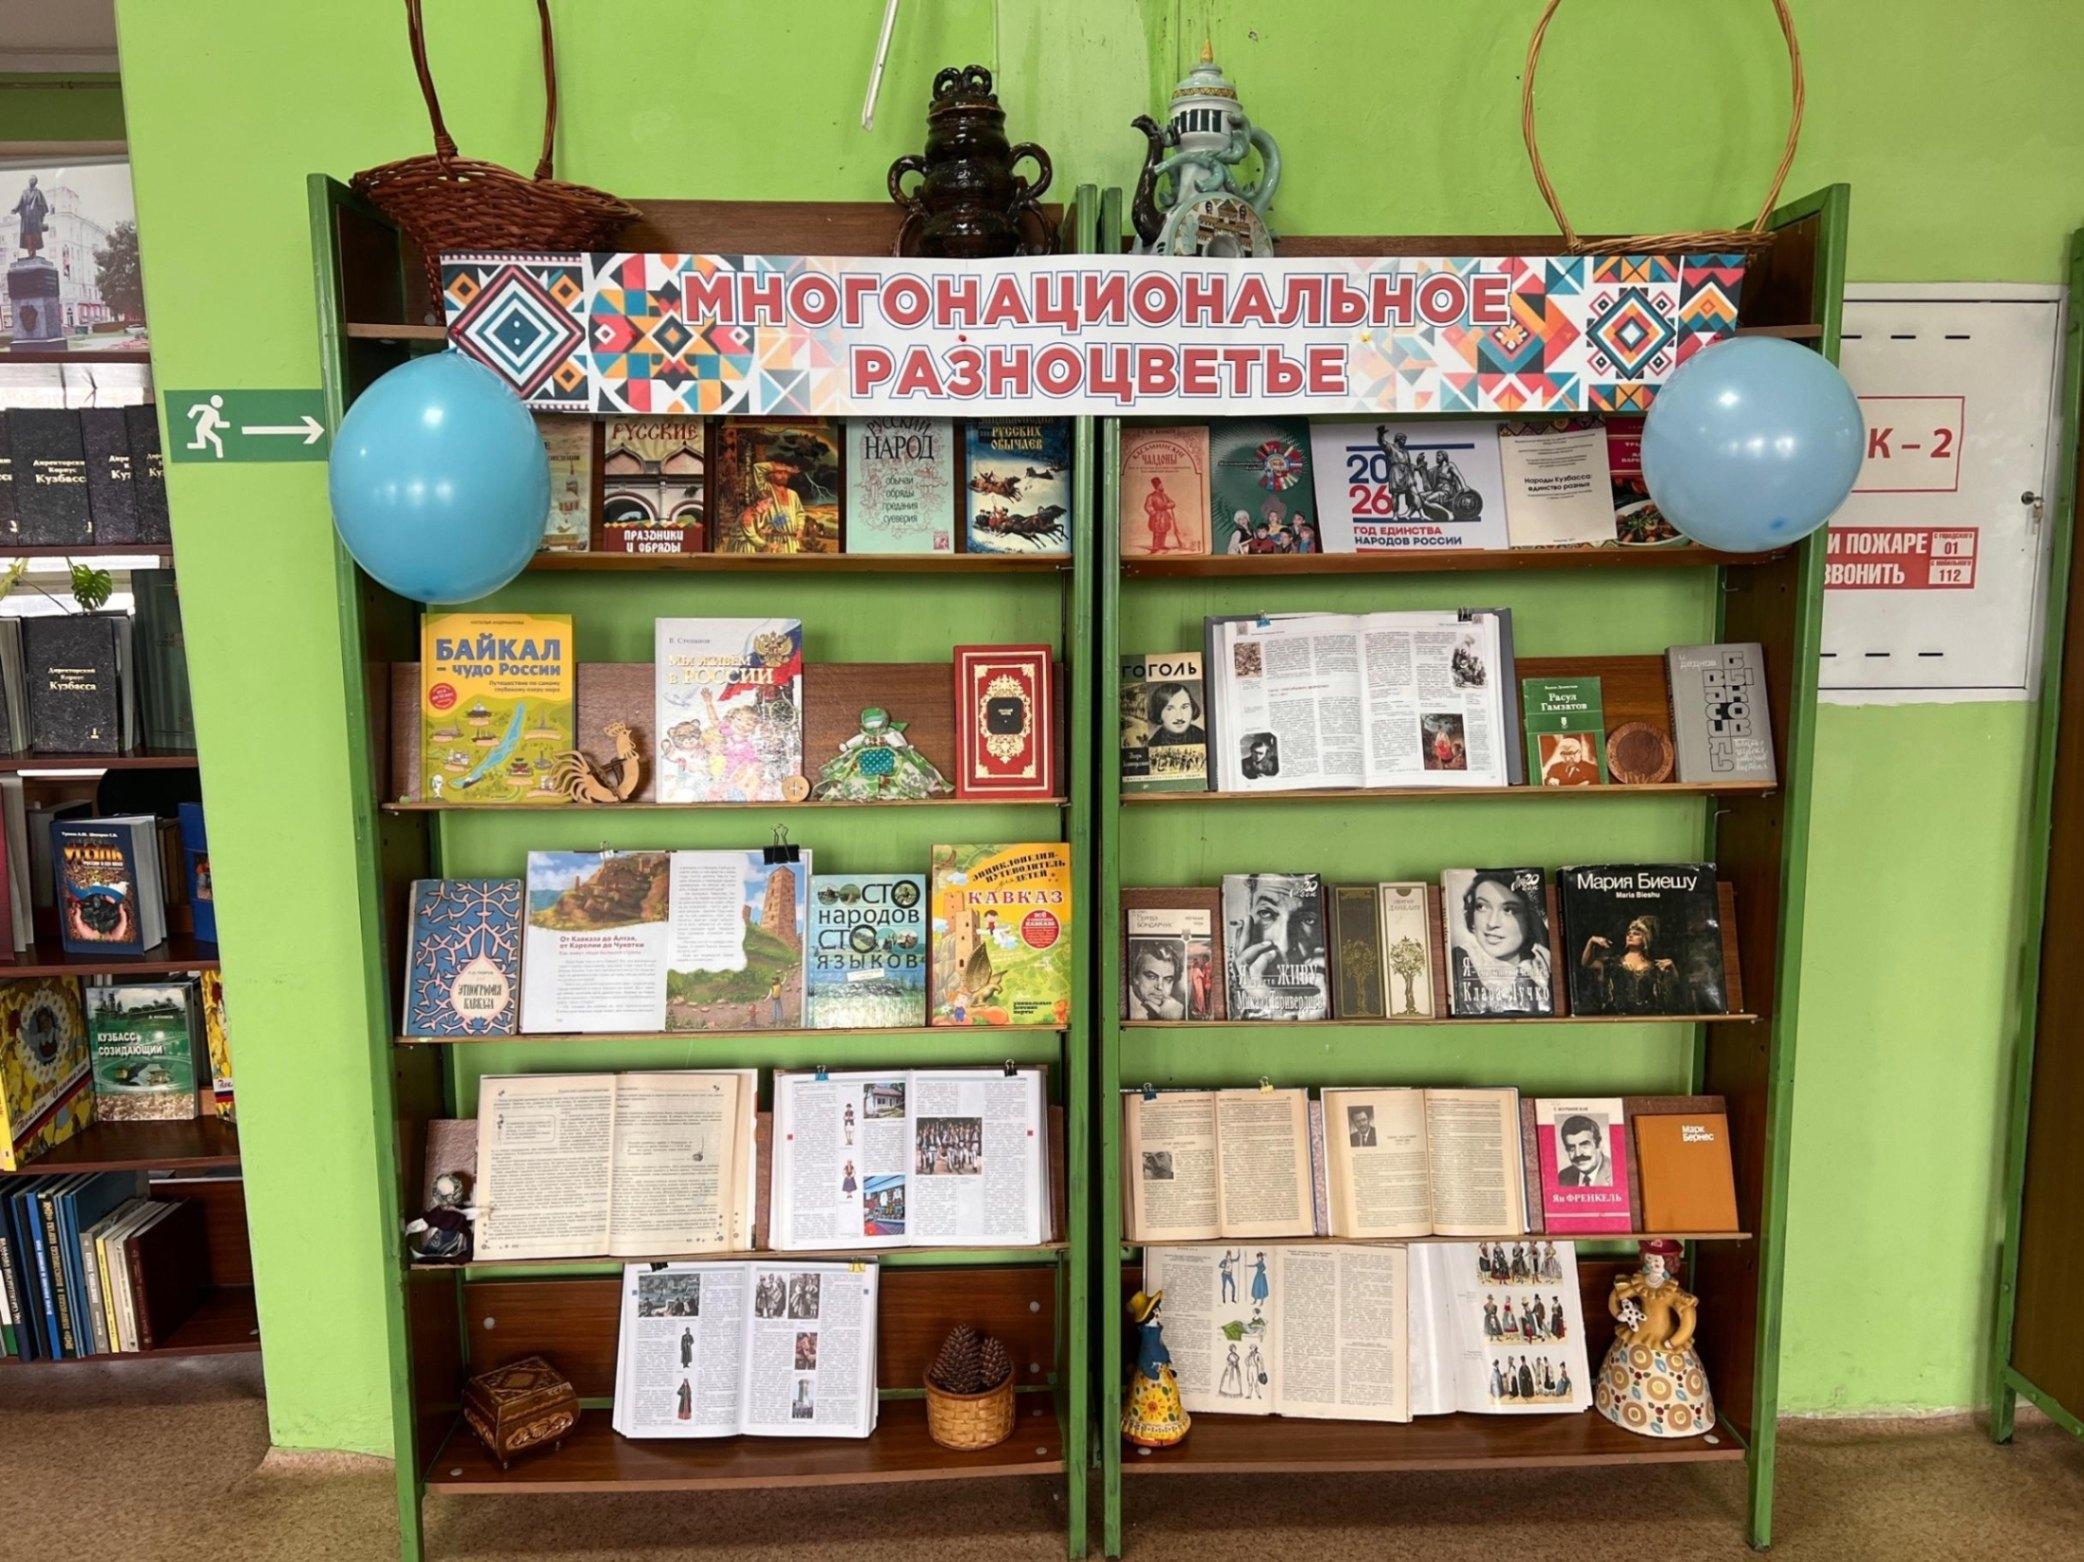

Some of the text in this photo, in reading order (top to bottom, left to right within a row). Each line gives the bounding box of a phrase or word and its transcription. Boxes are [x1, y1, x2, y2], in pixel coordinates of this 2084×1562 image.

[681, 272, 1512, 334] МНОГОНАЦИОНАЛЬНОЕ
[851, 343, 1348, 406] РАЗНОЦВЕТЬЕ
[611, 421, 699, 441] РУССКИЕ
[991, 425, 1042, 437] РУССКИХ
[864, 434, 935, 460] НАРОД
[1930, 427, 1953, 459] 2
[1346, 454, 1391, 484] 20
[885, 488, 915, 499] обряды
[1350, 485, 1393, 515] 26
[623, 529, 684, 541] ПРАЗДНИКИ
[1353, 526, 1443, 536] ГОД ЕДИНСТВА
[1354, 536, 1463, 546] НАРОДОВ РОССИИ
[1846, 532, 1928, 555] ПОЖАРЕ
[1944, 541, 1959, 555] 01
[1938, 569, 1962, 582] 112
[435, 632, 561, 661] БАЙКАЛ
[683, 667, 775, 685] РОССИИ
[1120, 662, 1198, 679] ГОГОЛЬ
[49, 681, 97, 691] Кузбасса
[1548, 692, 1577, 704] Расул
[1541, 702, 1588, 712] Гамзатов
[1577, 872, 1698, 892] Мария Биешу
[861, 879, 921, 909] СТО
[968, 889, 1064, 905] КАВКАЗ
[818, 908, 920, 927] народов
[818, 923, 878, 954] СТО
[1462, 980, 1550, 1007] Клара Лучко
[98, 1043, 164, 1056] СОЗИДАЮЩИЙ
[1682, 1132, 1714, 1142] Бернес
[1552, 1193, 1622, 1203] Ян ФРЕНКЕЛЬ
